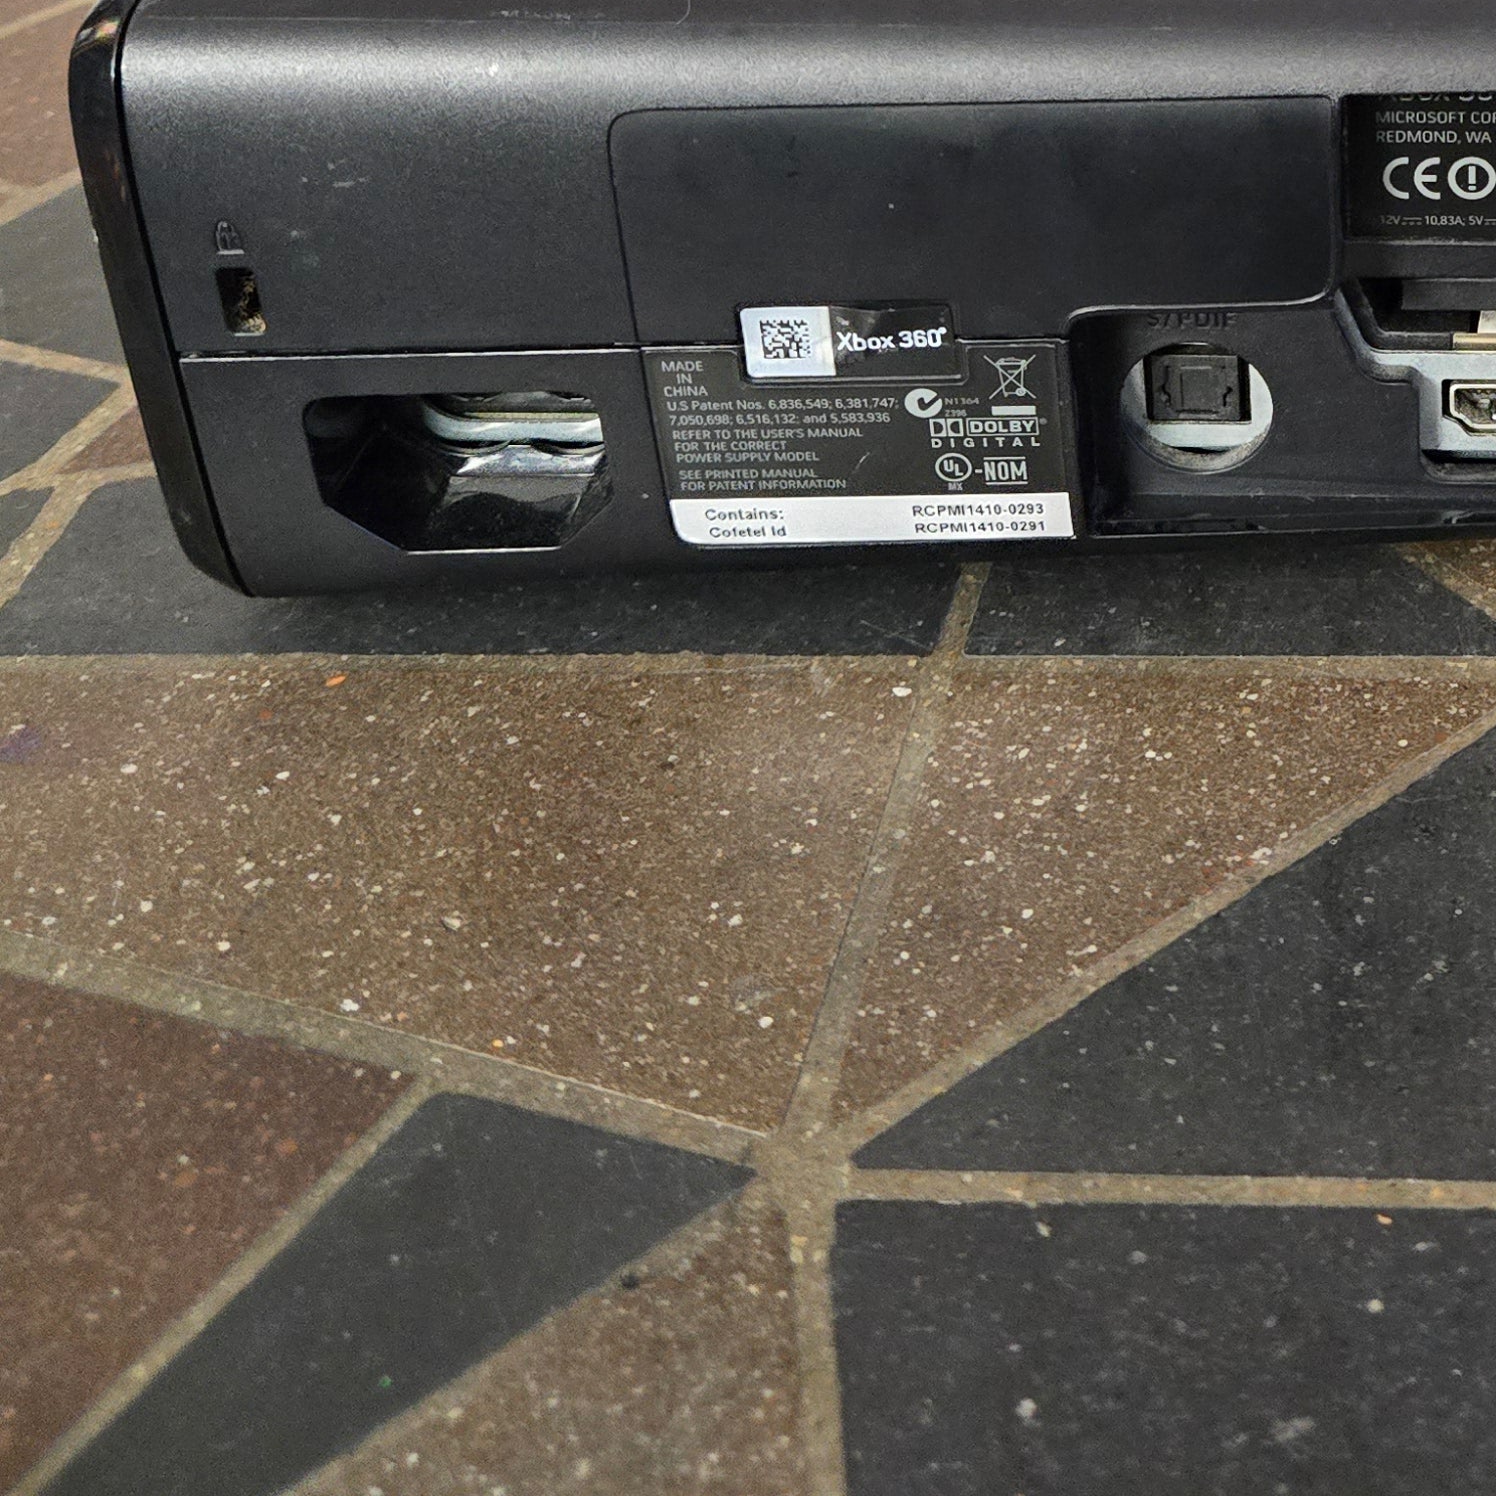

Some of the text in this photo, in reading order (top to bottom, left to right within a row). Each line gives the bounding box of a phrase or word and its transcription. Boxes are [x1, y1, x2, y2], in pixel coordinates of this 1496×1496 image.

[1376, 111, 1466, 125] MICROSOFT
[1376, 131, 1462, 144] REDMOND,
[1465, 132, 1492, 144] WA
[1382, 156, 1441, 200] CE
[836, 331, 896, 352] Xbox
[661, 361, 704, 373] MADE
[676, 373, 693, 384] IN
[663, 385, 708, 397] CHINA
[691, 400, 734, 411] Patent
[802, 413, 828, 424] and
[970, 420, 1034, 433] DOLBY
[673, 428, 863, 440] REFER TO THE USER'S MANUAL
[674, 440, 787, 452] FOR THE CORRECT
[931, 437, 1040, 448] DIGITAL
[676, 451, 820, 463] POWER SUPPLY MODEL
[679, 467, 819, 480] SEE PRINTED MANUAL
[681, 478, 847, 491] FOR PATENT INFORMATION
[704, 507, 785, 521] Contains:
[709, 526, 766, 538] Cofetel
